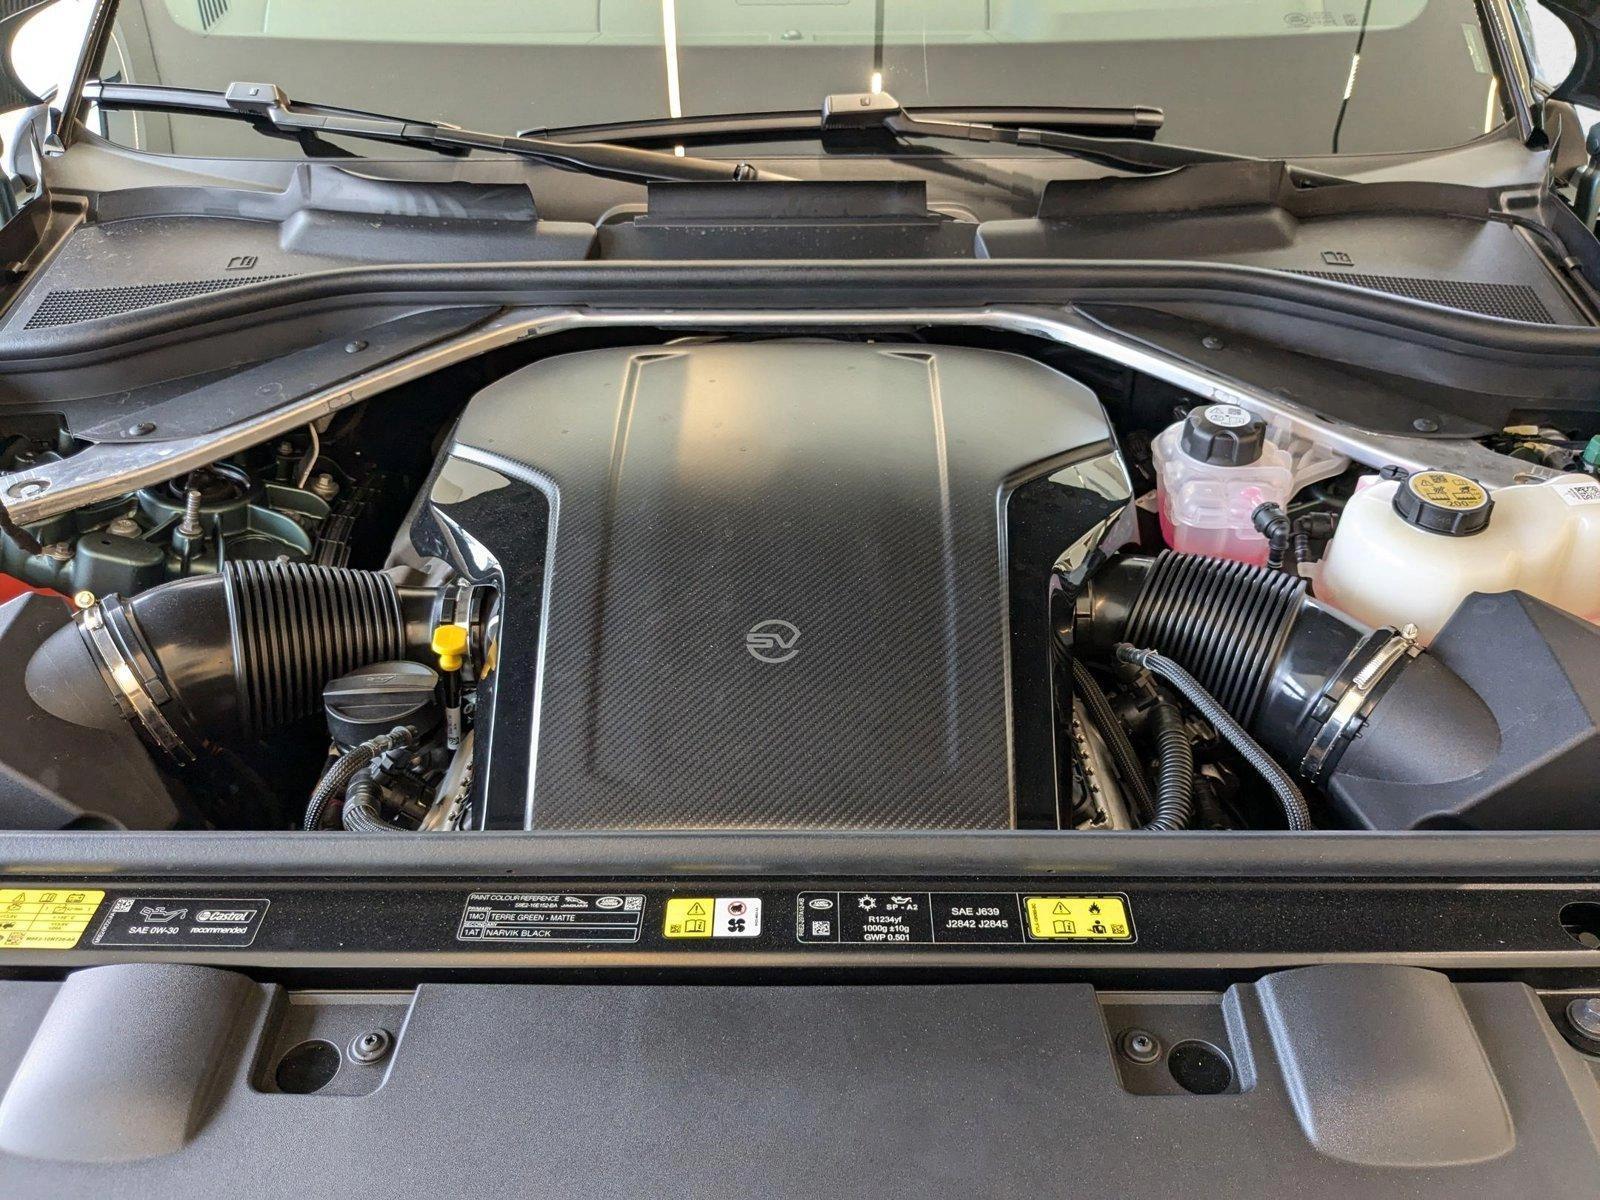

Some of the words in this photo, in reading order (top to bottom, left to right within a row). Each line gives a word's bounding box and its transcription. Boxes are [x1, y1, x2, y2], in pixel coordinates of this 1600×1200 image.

[886, 903, 899, 911] SP
[951, 907, 974, 916] SAE
[975, 907, 1000, 916] J639
[209, 911, 249, 921] Castrol
[490, 913, 516, 921] TERRE
[550, 914, 576, 922] MATTE
[868, 915, 902, 924] R1234yf
[946, 919, 976, 928] J2842
[978, 919, 1009, 928] J2845
[128, 926, 150, 934] SAE
[150, 926, 180, 934] 0W-30
[189, 926, 248, 934] recommended
[485, 929, 519, 937] NARVIK
[520, 929, 552, 937] BLACK
[863, 924, 888, 933] 1000g
[889, 924, 910, 933] ±10g
[863, 933, 886, 941] GWP
[887, 933, 910, 941] 0.501
